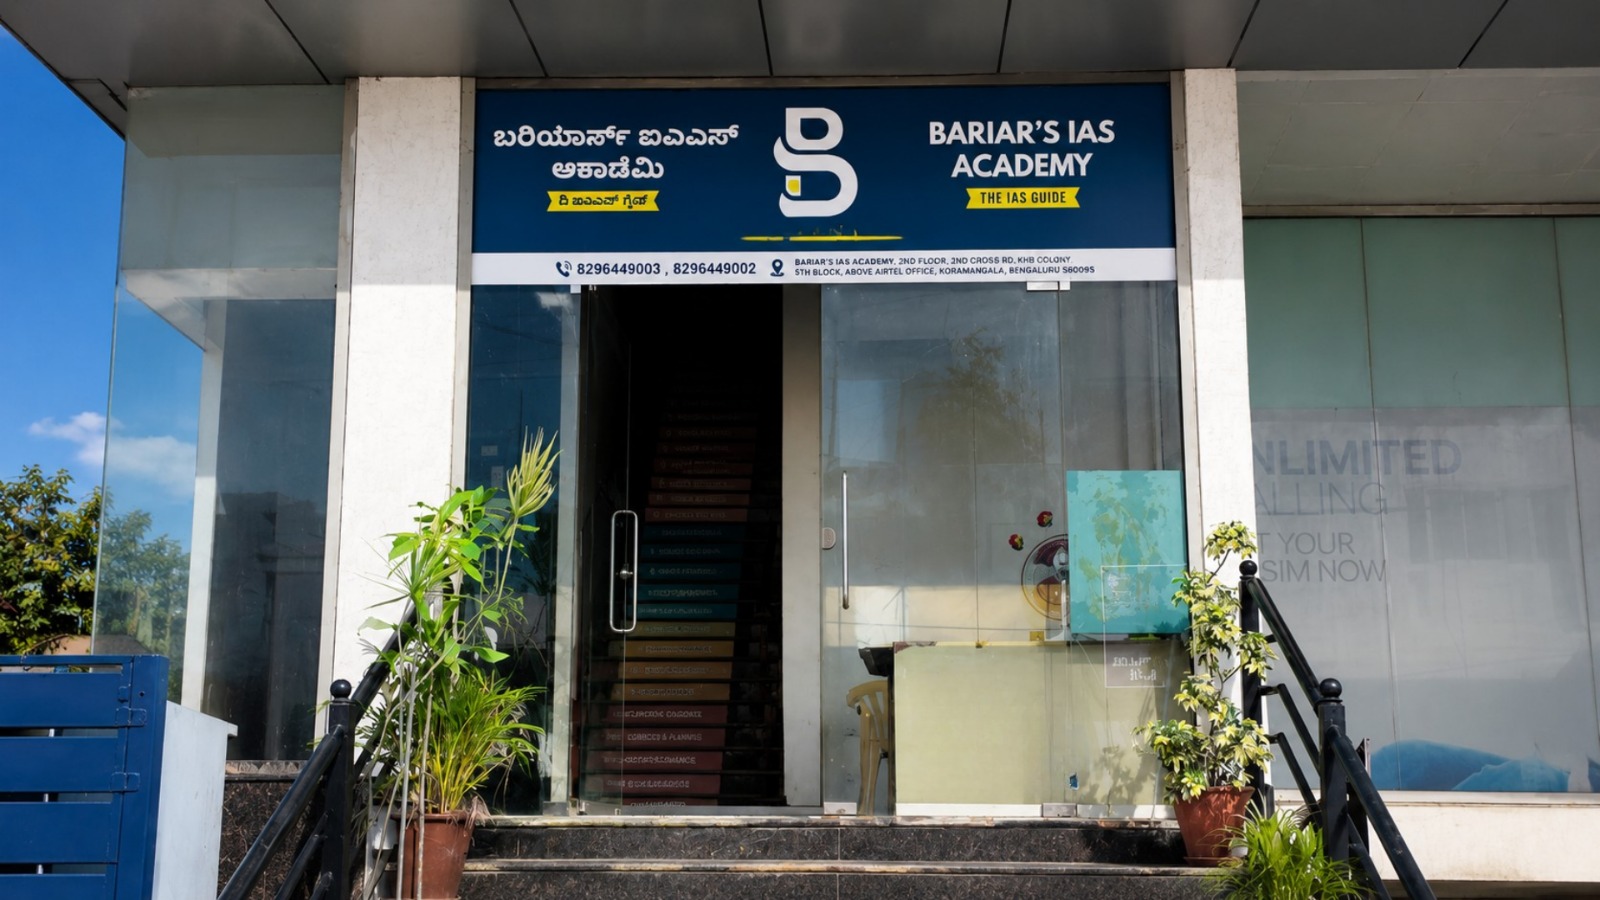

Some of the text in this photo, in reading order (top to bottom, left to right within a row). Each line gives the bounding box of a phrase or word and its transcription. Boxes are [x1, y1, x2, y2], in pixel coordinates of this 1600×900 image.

[638, 124, 740, 146] ಐಎಎಸ್
[929, 119, 1115, 145] BARIAR'S IAS
[951, 152, 1093, 178] ACADEMY
[980, 190, 1066, 204] THE IAS GUIDE
[576, 263, 661, 275] 8296449003
[673, 262, 756, 274] 8296449002
[794, 258, 834, 266] BARIAR'S
[898, 257, 916, 265] 2ND
[969, 256, 1000, 264] CROSS
[1018, 256, 1035, 264] KHB
[812, 268, 843, 277] BLOCK,
[845, 268, 873, 276] ABOVE
[874, 267, 903, 275] AIRTEL
[905, 267, 937, 276] OFFICE,
[939, 267, 1007, 275] KORAMANGALA,
[1009, 266, 1060, 274] BENGALURU
[1252, 439, 1462, 476] NLIMITED
[1277, 532, 1355, 555] YOUR
[1261, 559, 1386, 583] SIM NOW
